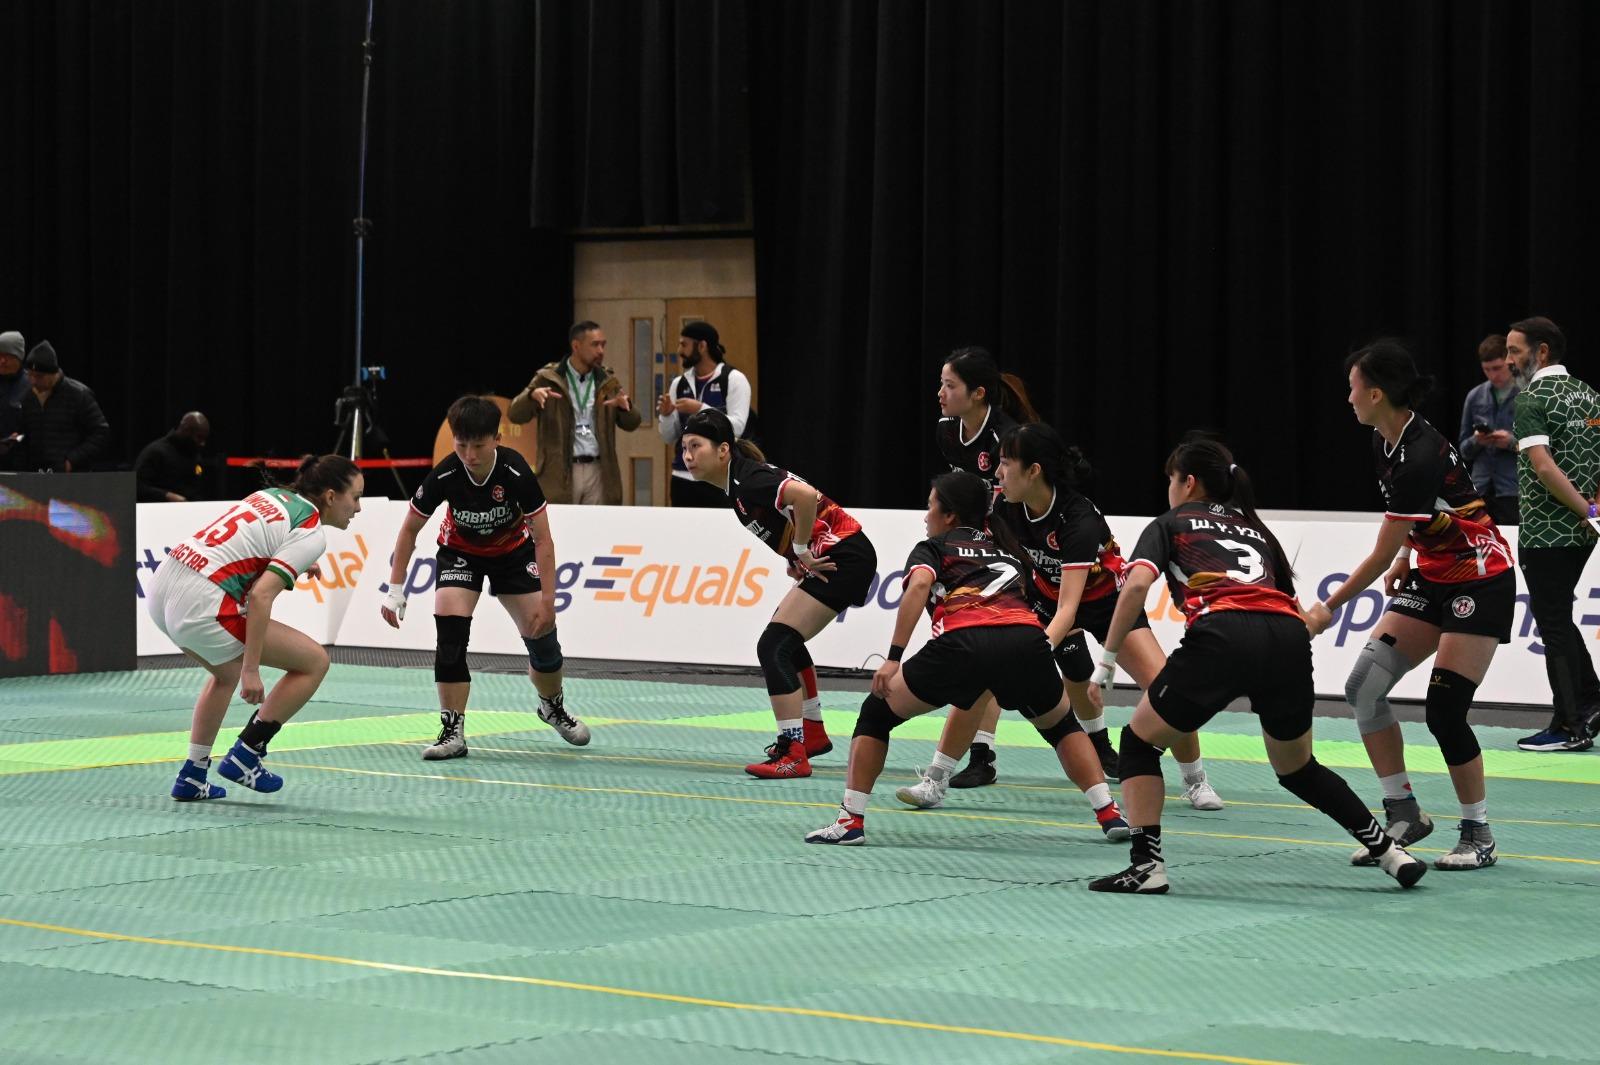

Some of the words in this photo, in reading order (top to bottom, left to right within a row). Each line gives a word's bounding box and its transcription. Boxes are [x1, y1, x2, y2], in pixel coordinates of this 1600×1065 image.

[192, 504, 258, 548] 15
[583, 544, 771, 617] Equals
[978, 561, 1021, 599] 7
[1213, 539, 1268, 585] 3
